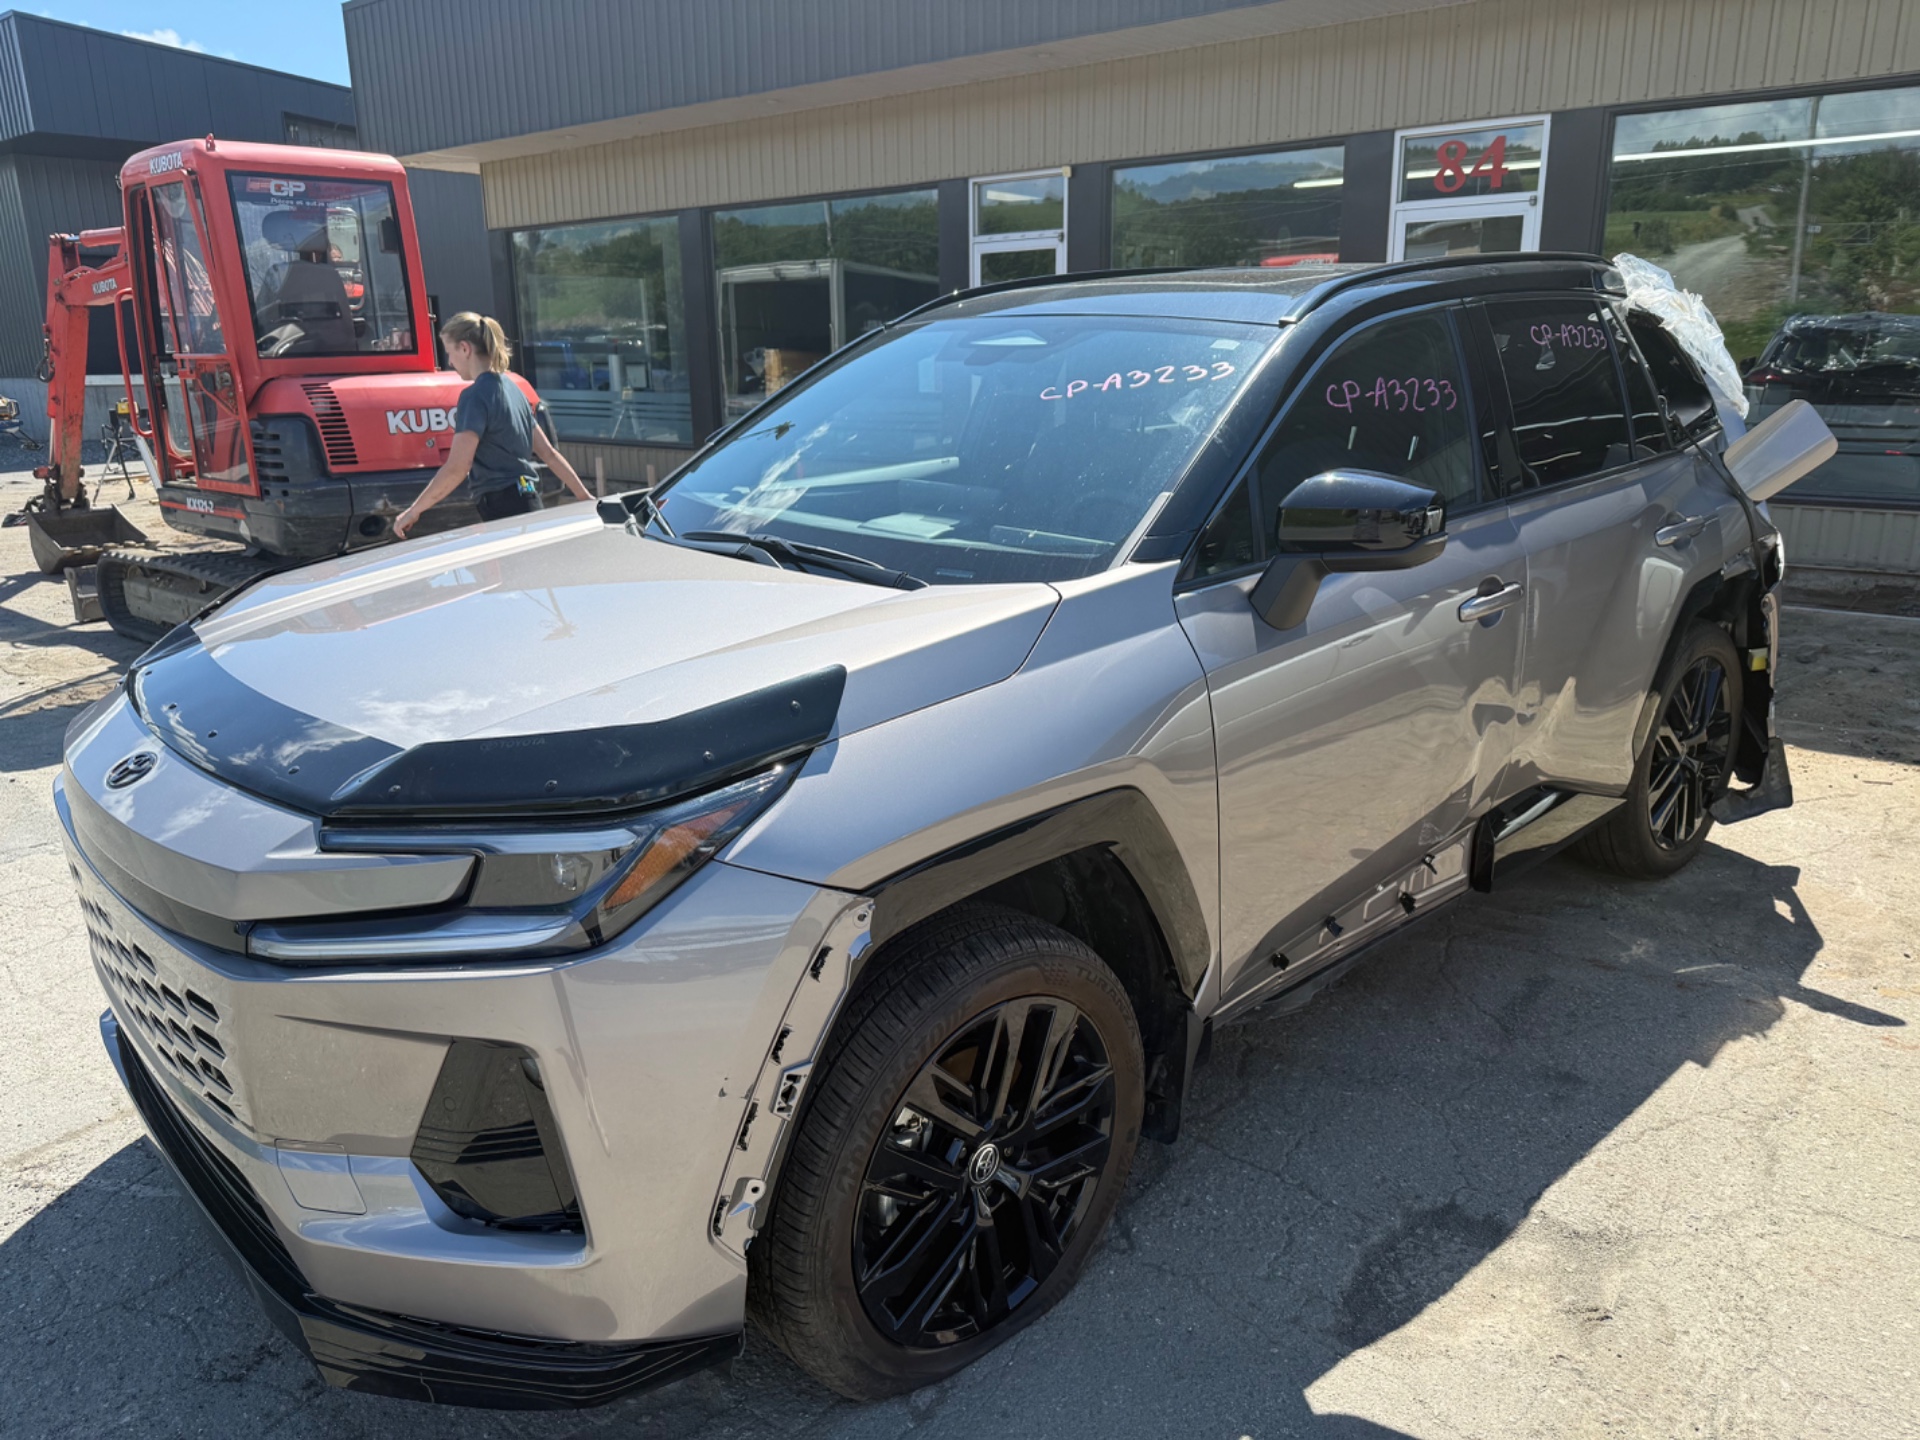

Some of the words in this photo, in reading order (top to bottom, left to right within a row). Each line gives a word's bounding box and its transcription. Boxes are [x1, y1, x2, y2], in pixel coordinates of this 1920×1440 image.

[149, 152, 184, 174] KUBOTA
[434, 135, 509, 193] 84
[92, 278, 118, 294] KUBOTA
[1530, 323, 1608, 350] CP-A3233
[1040, 361, 1236, 400] CP-A3233
[1326, 377, 1457, 413] CP-A3233
